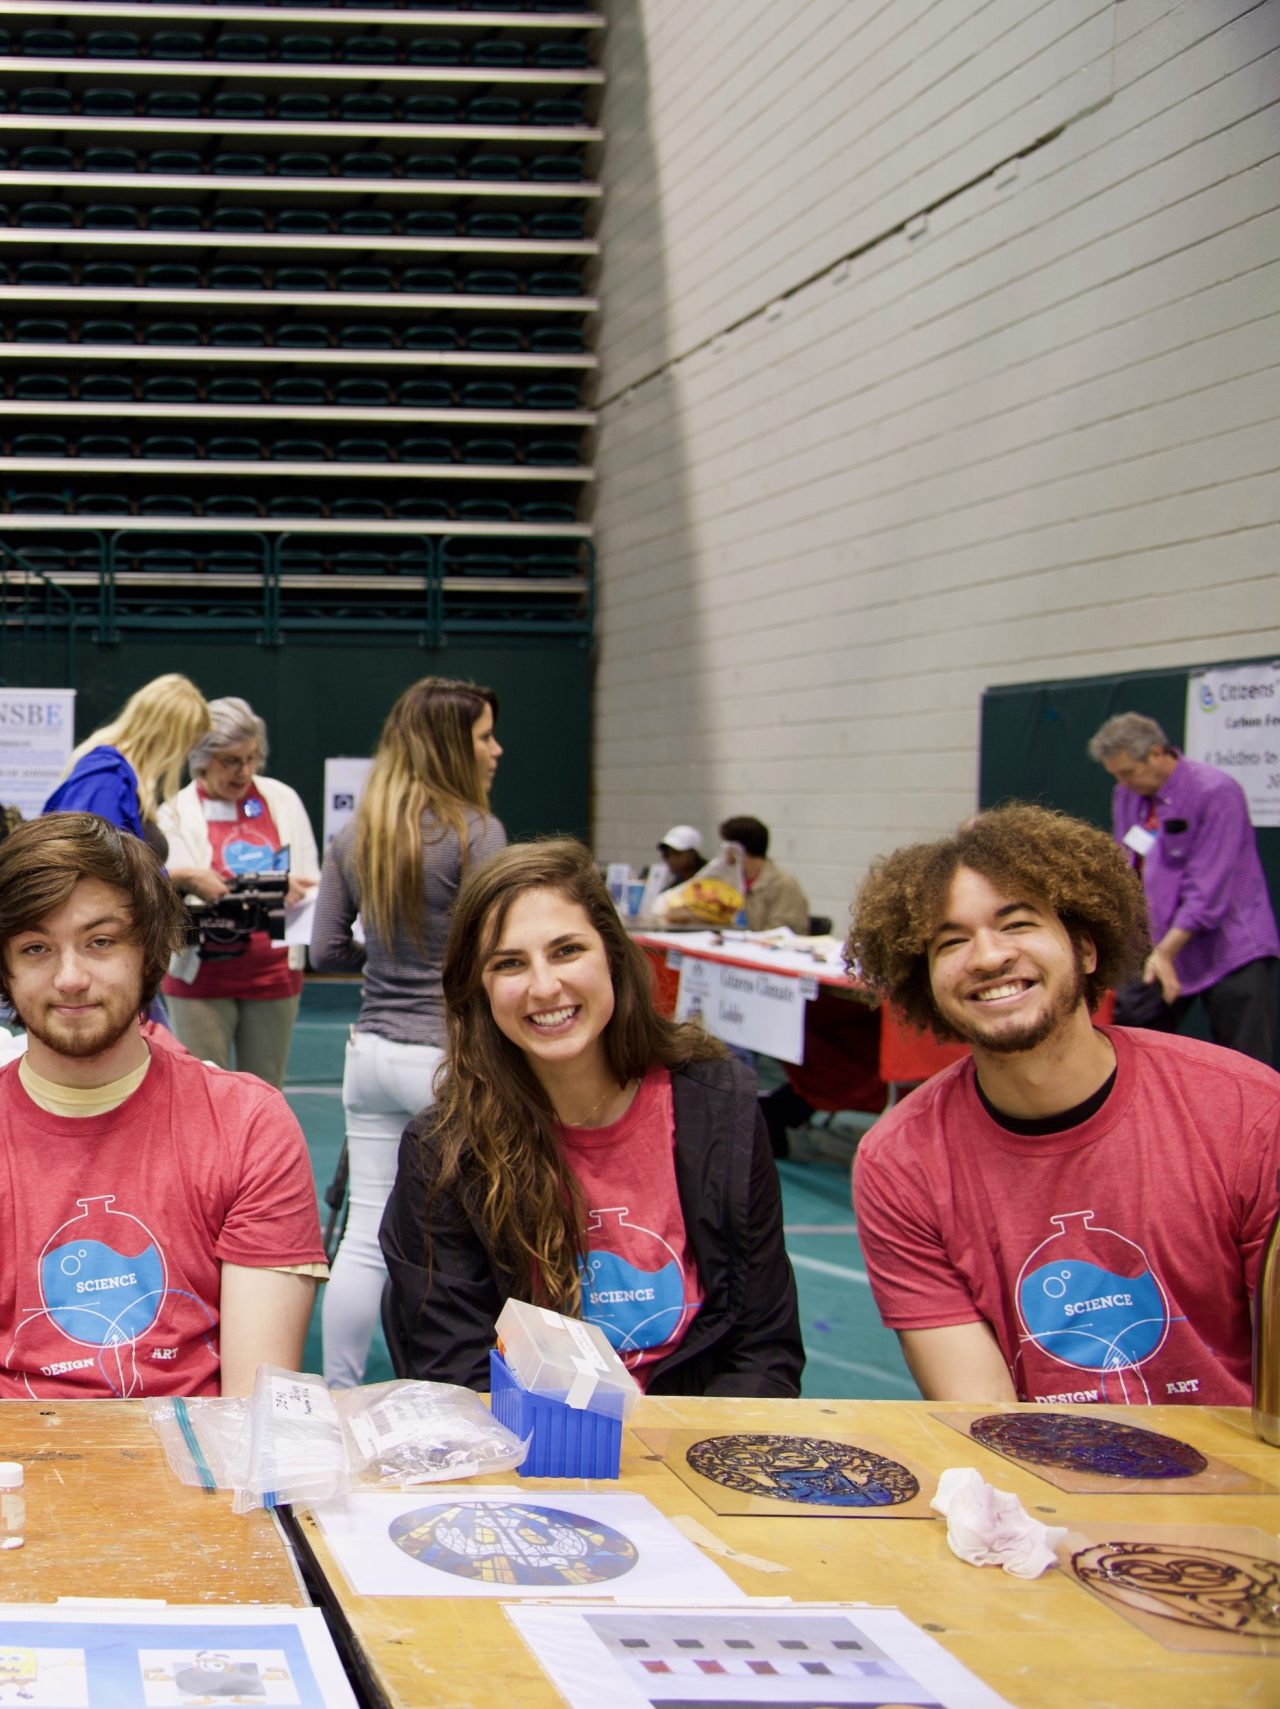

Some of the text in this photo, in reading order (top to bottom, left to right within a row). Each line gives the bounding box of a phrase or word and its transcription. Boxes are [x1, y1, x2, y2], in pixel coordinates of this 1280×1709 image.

[76, 1273, 138, 1293] SCIENCE
[590, 1288, 655, 1304] SCIENCE
[1064, 1293, 1133, 1317] SCIENCE
[151, 1347, 179, 1360] ART
[40, 1357, 95, 1377] DESIGN
[1165, 1379, 1199, 1395] ART
[1034, 1389, 1099, 1403] DESIGN
